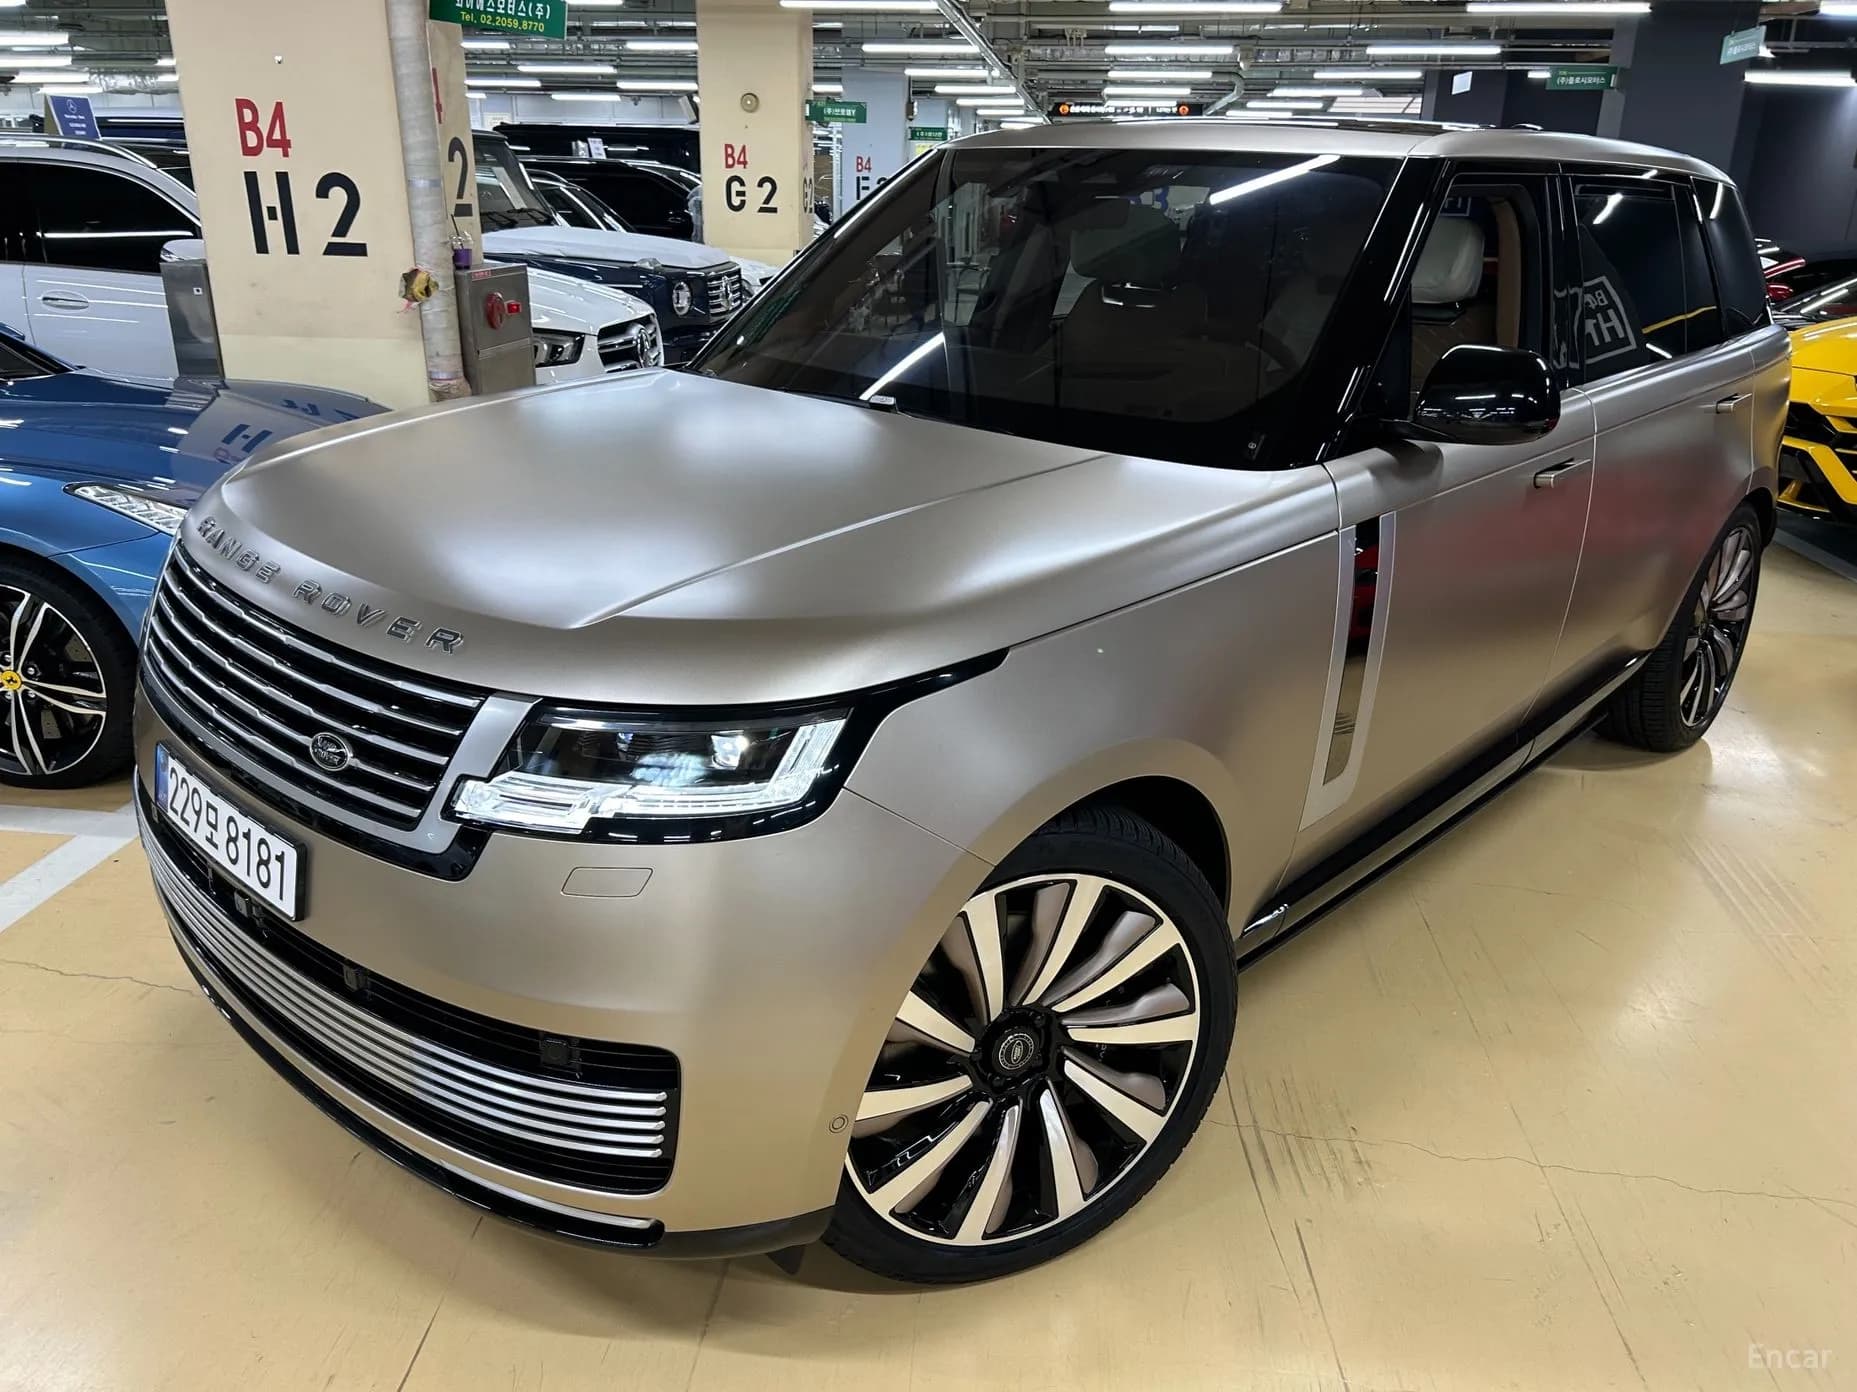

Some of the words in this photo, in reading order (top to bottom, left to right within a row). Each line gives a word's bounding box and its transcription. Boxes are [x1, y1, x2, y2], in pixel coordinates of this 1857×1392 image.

[460, 11, 477, 24] Tel.
[480, 14, 545, 33] 02.2059.8770
[235, 98, 292, 158] B4
[724, 144, 748, 169] B4
[856, 155, 872, 173] B4
[197, 516, 281, 585] RANGE
[293, 578, 465, 655] ROVER
[226, 815, 285, 901] 8181
